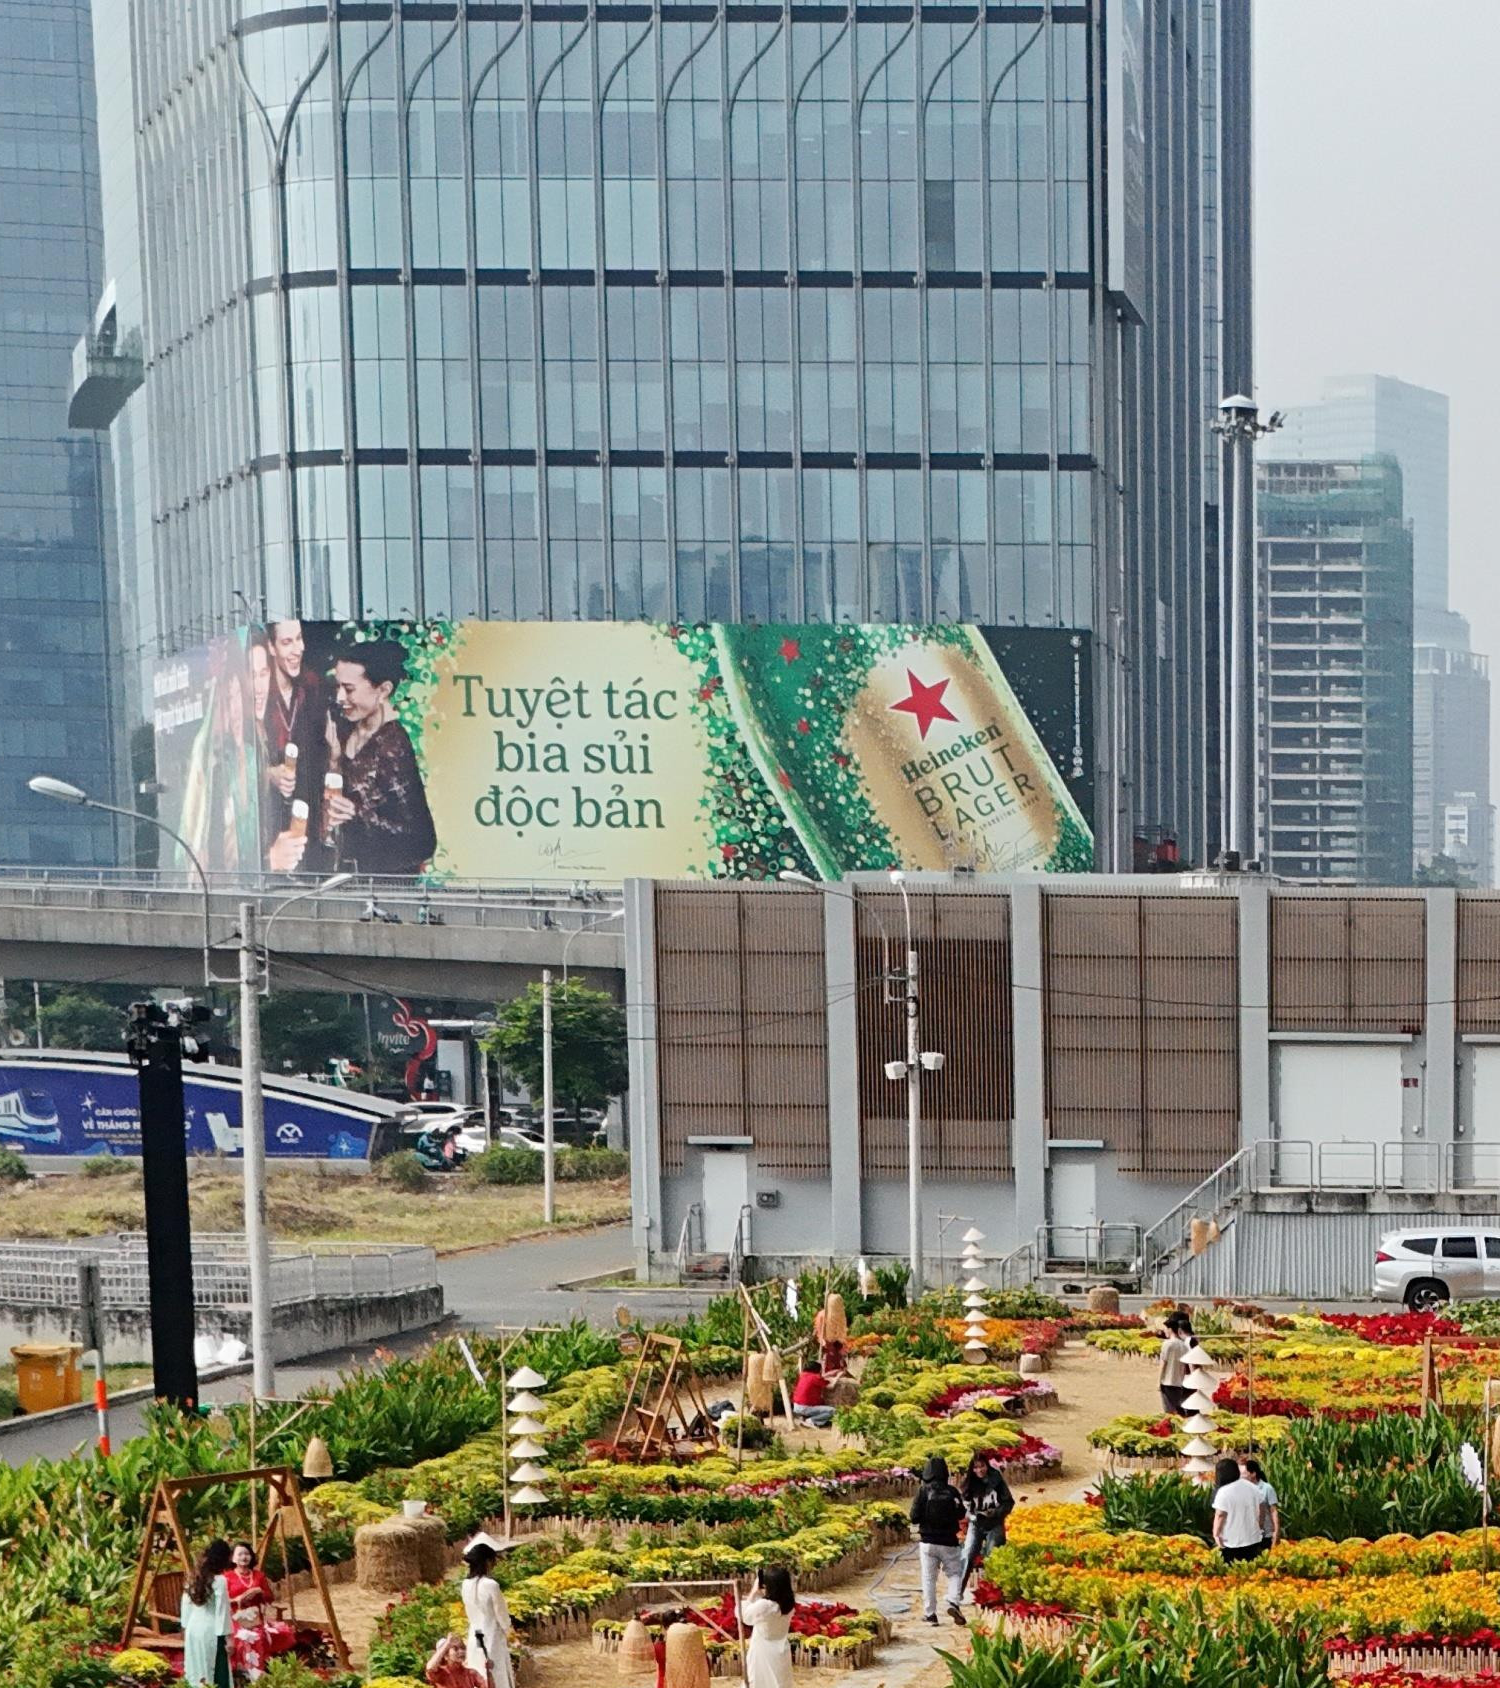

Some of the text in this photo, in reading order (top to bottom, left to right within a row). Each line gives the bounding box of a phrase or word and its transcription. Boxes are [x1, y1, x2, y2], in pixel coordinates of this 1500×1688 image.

[452, 674, 678, 730] Tuyệt tác
[493, 729, 654, 775] bia sủi
[901, 722, 1004, 785] Heineken
[914, 742, 1015, 818] BRUT
[474, 784, 666, 838] độc bản
[931, 772, 1036, 841] LAGER
